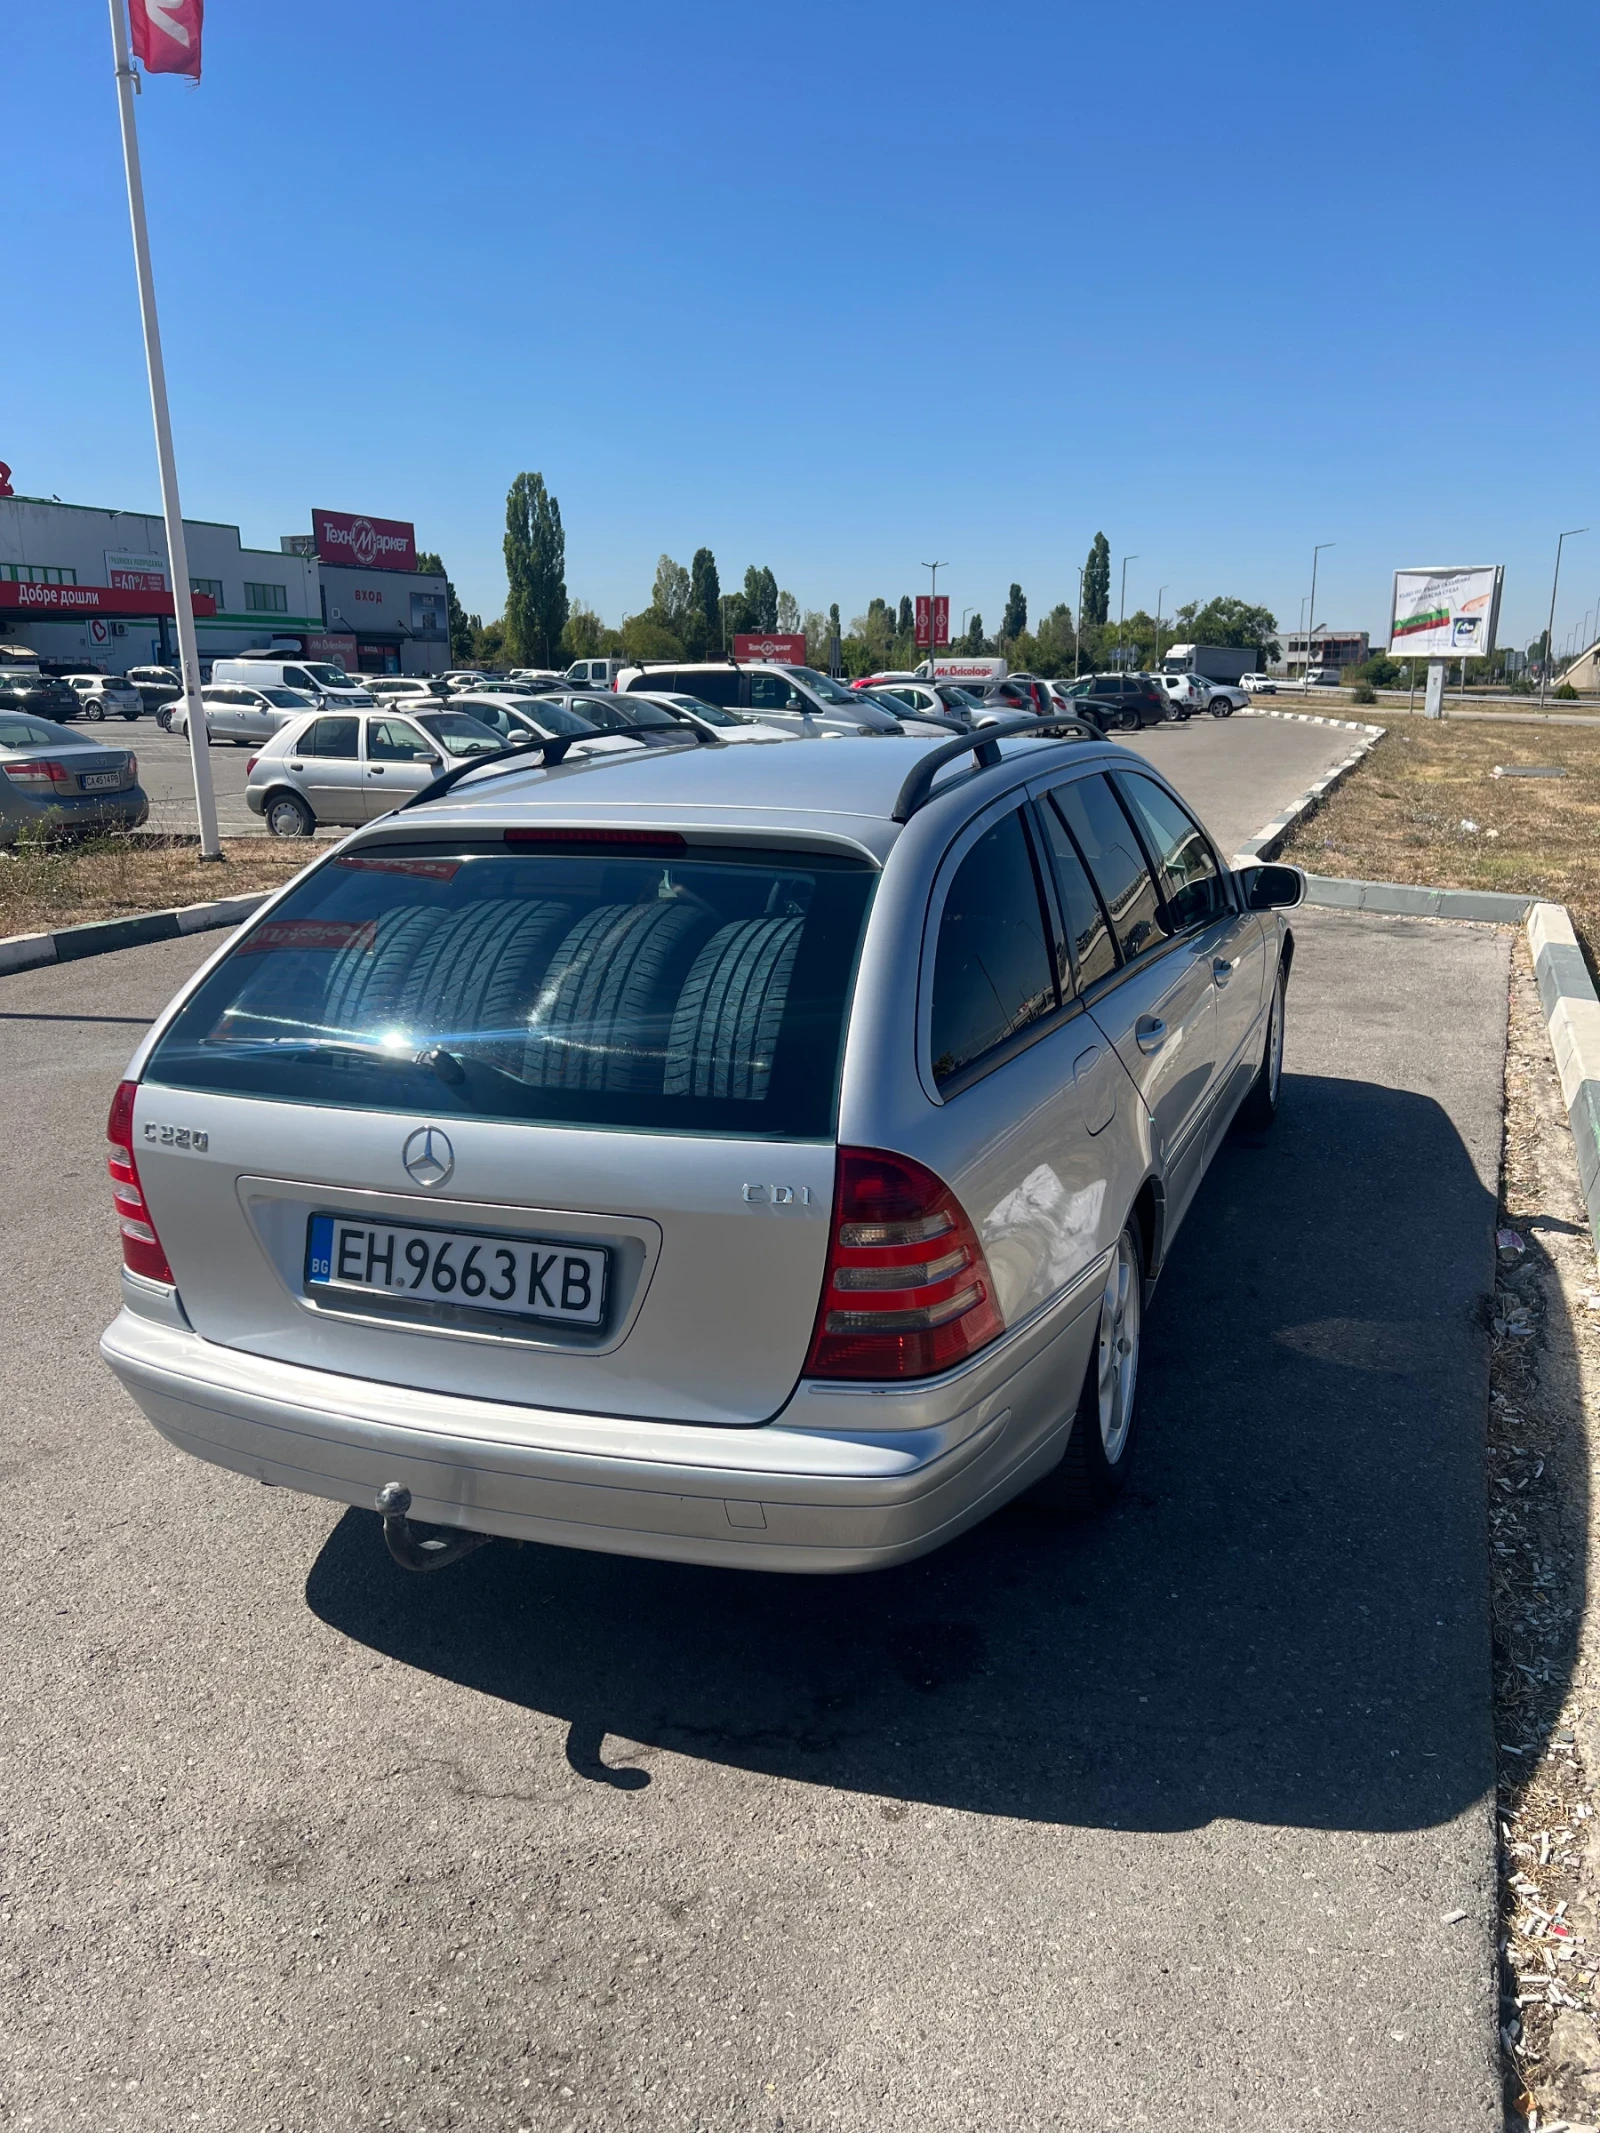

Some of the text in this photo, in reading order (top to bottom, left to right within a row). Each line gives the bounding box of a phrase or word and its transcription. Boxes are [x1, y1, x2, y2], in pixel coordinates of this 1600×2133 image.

[18, 584, 99, 606] Добре дошли
[355, 590, 383, 604] ВХОД
[949, 665, 993, 677] Bricolage
[742, 1183, 811, 1206] CDI
[311, 1257, 330, 1274] BG
